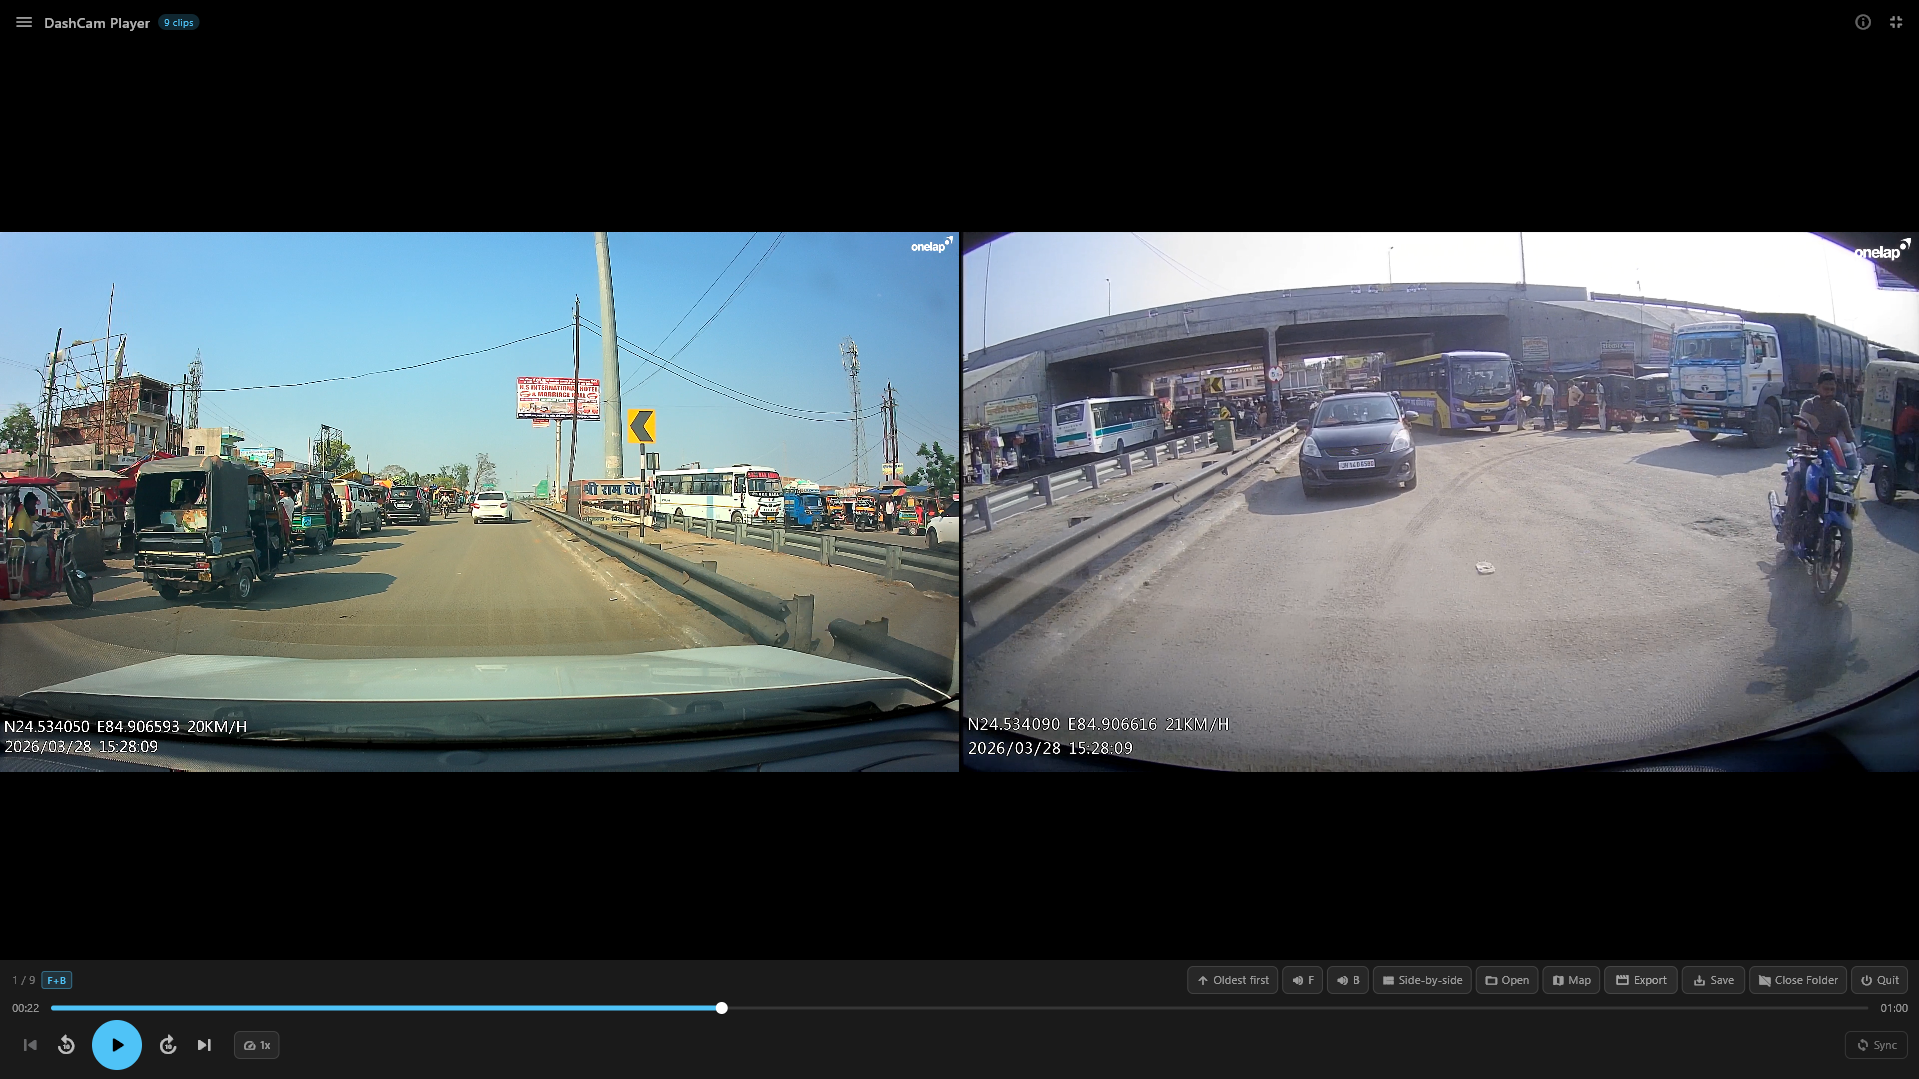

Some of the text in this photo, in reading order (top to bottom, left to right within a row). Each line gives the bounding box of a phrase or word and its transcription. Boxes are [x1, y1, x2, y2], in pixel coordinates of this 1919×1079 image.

[44, 17, 151, 32] DashCam Player
[163, 18, 194, 29] 9 clips
[600, 484, 622, 496] राम
[12, 975, 36, 986] 1 / 9
[47, 976, 67, 985] F+B
[1213, 975, 1270, 985] Oldest first
[1308, 975, 1315, 985] F
[1353, 975, 1361, 985] B
[1398, 975, 1463, 987] Side-by-side
[1501, 975, 1530, 987] Open
[1568, 975, 1592, 987] Map
[1634, 975, 1668, 987] Export
[1710, 975, 1735, 985] Save
[1775, 975, 1839, 985] Close Folder
[1876, 975, 1900, 986] Quit
[11, 1003, 40, 1013] 00:22
[1880, 1003, 1909, 1013] 01:00
[259, 1040, 271, 1050] 1x
[1873, 1040, 1898, 1052] Sync
